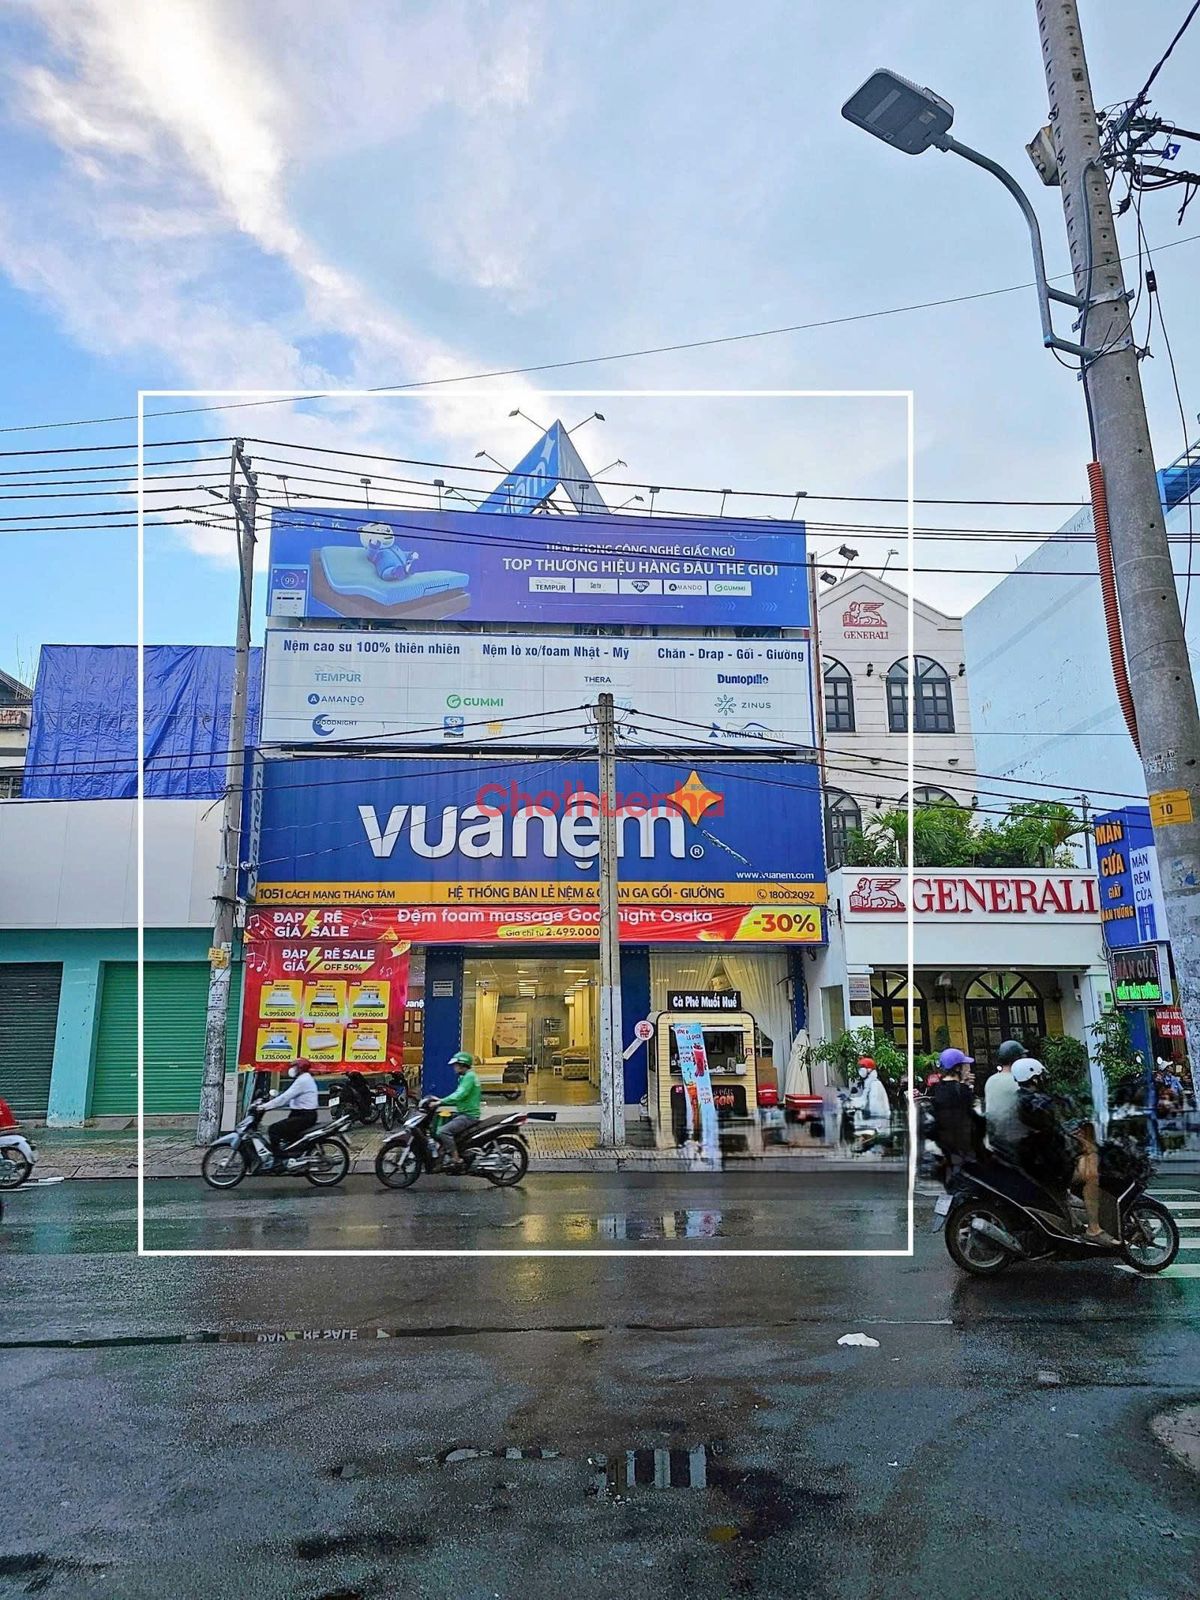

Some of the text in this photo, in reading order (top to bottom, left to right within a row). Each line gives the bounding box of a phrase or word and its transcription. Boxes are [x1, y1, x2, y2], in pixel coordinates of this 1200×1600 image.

[683, 543, 710, 556] GIẤC
[711, 544, 736, 556] NGỦ
[502, 558, 533, 571] TOP
[535, 558, 598, 572] THƯƠNG
[601, 558, 638, 575] HIỆU
[639, 560, 682, 575] HÀNG
[843, 631, 889, 640] GENERALI
[283, 639, 461, 655] Nệm cao su 100% thiên nhiên
[482, 643, 510, 658] Nệm
[511, 644, 522, 656] lò
[525, 644, 570, 658] xo/foam
[574, 645, 602, 659] Nhật
[612, 646, 630, 660] Mỹ
[658, 647, 686, 659] Chăn
[698, 649, 724, 661] Drap
[737, 647, 755, 660] Gối
[766, 649, 804, 662] Giường
[315, 672, 362, 683] TEMPUR
[717, 673, 769, 686] Dunlopillo
[320, 695, 365, 704] AMANDO
[463, 697, 504, 706] GUMMI
[741, 701, 772, 709] ZINUS
[1159, 803, 1173, 815] 10
[357, 791, 686, 869] vuanệm
[1095, 817, 1122, 846] MÀN
[1101, 848, 1125, 877] CỬA
[1131, 853, 1149, 868] MÀN
[258, 888, 396, 901] 1051 CÁCH MẠNG THÁNG TÁM
[448, 886, 464, 901] HỆ
[467, 884, 510, 898] THỐNG
[513, 885, 538, 898] BÁN
[541, 884, 555, 898] LẺ
[557, 886, 584, 901] NỆM
[585, 887, 595, 898] &
[632, 888, 649, 898] GA
[651, 885, 673, 898] GỐI
[680, 886, 724, 899] GIƯỜNG
[912, 878, 1099, 914] GENERALI
[397, 907, 713, 926] Đệm foam massage Goonight Osaka
[753, 913, 816, 932] -30%
[311, 925, 350, 937] SALE
[546, 927, 600, 936] 2.499.000
[342, 949, 375, 960] SALE
[324, 963, 363, 971] OFF 50%
[673, 994, 684, 1008] Cà
[701, 992, 720, 1008] Muối
[722, 992, 738, 1008] Huế
